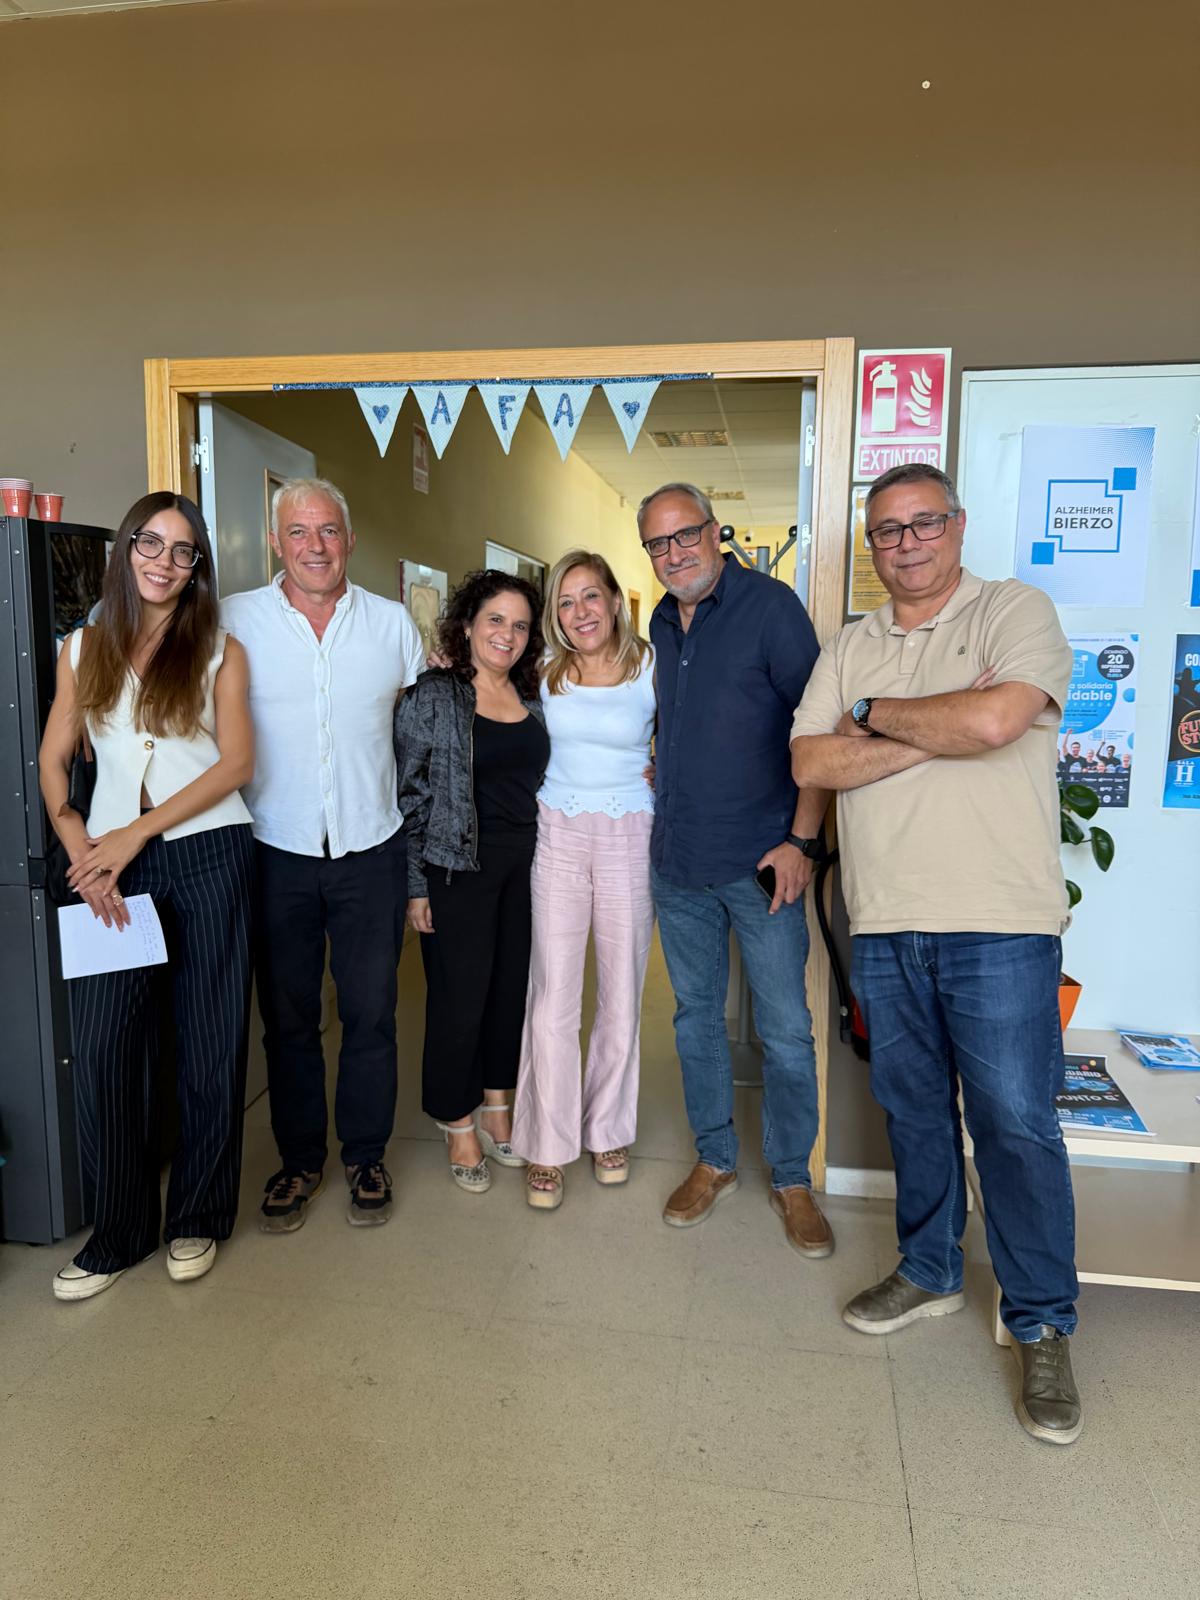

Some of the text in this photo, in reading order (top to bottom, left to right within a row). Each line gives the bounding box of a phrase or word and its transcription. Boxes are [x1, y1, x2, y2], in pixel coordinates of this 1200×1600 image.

[859, 447, 939, 471] EXTINTOR
[1054, 505, 1115, 515] ALZHEIMER
[1053, 516, 1114, 530] BIERZO
[1106, 654, 1124, 665] 20
[1184, 652, 1200, 667] CO
[1076, 681, 1114, 690] solidaria
[1067, 688, 1113, 701] idable
